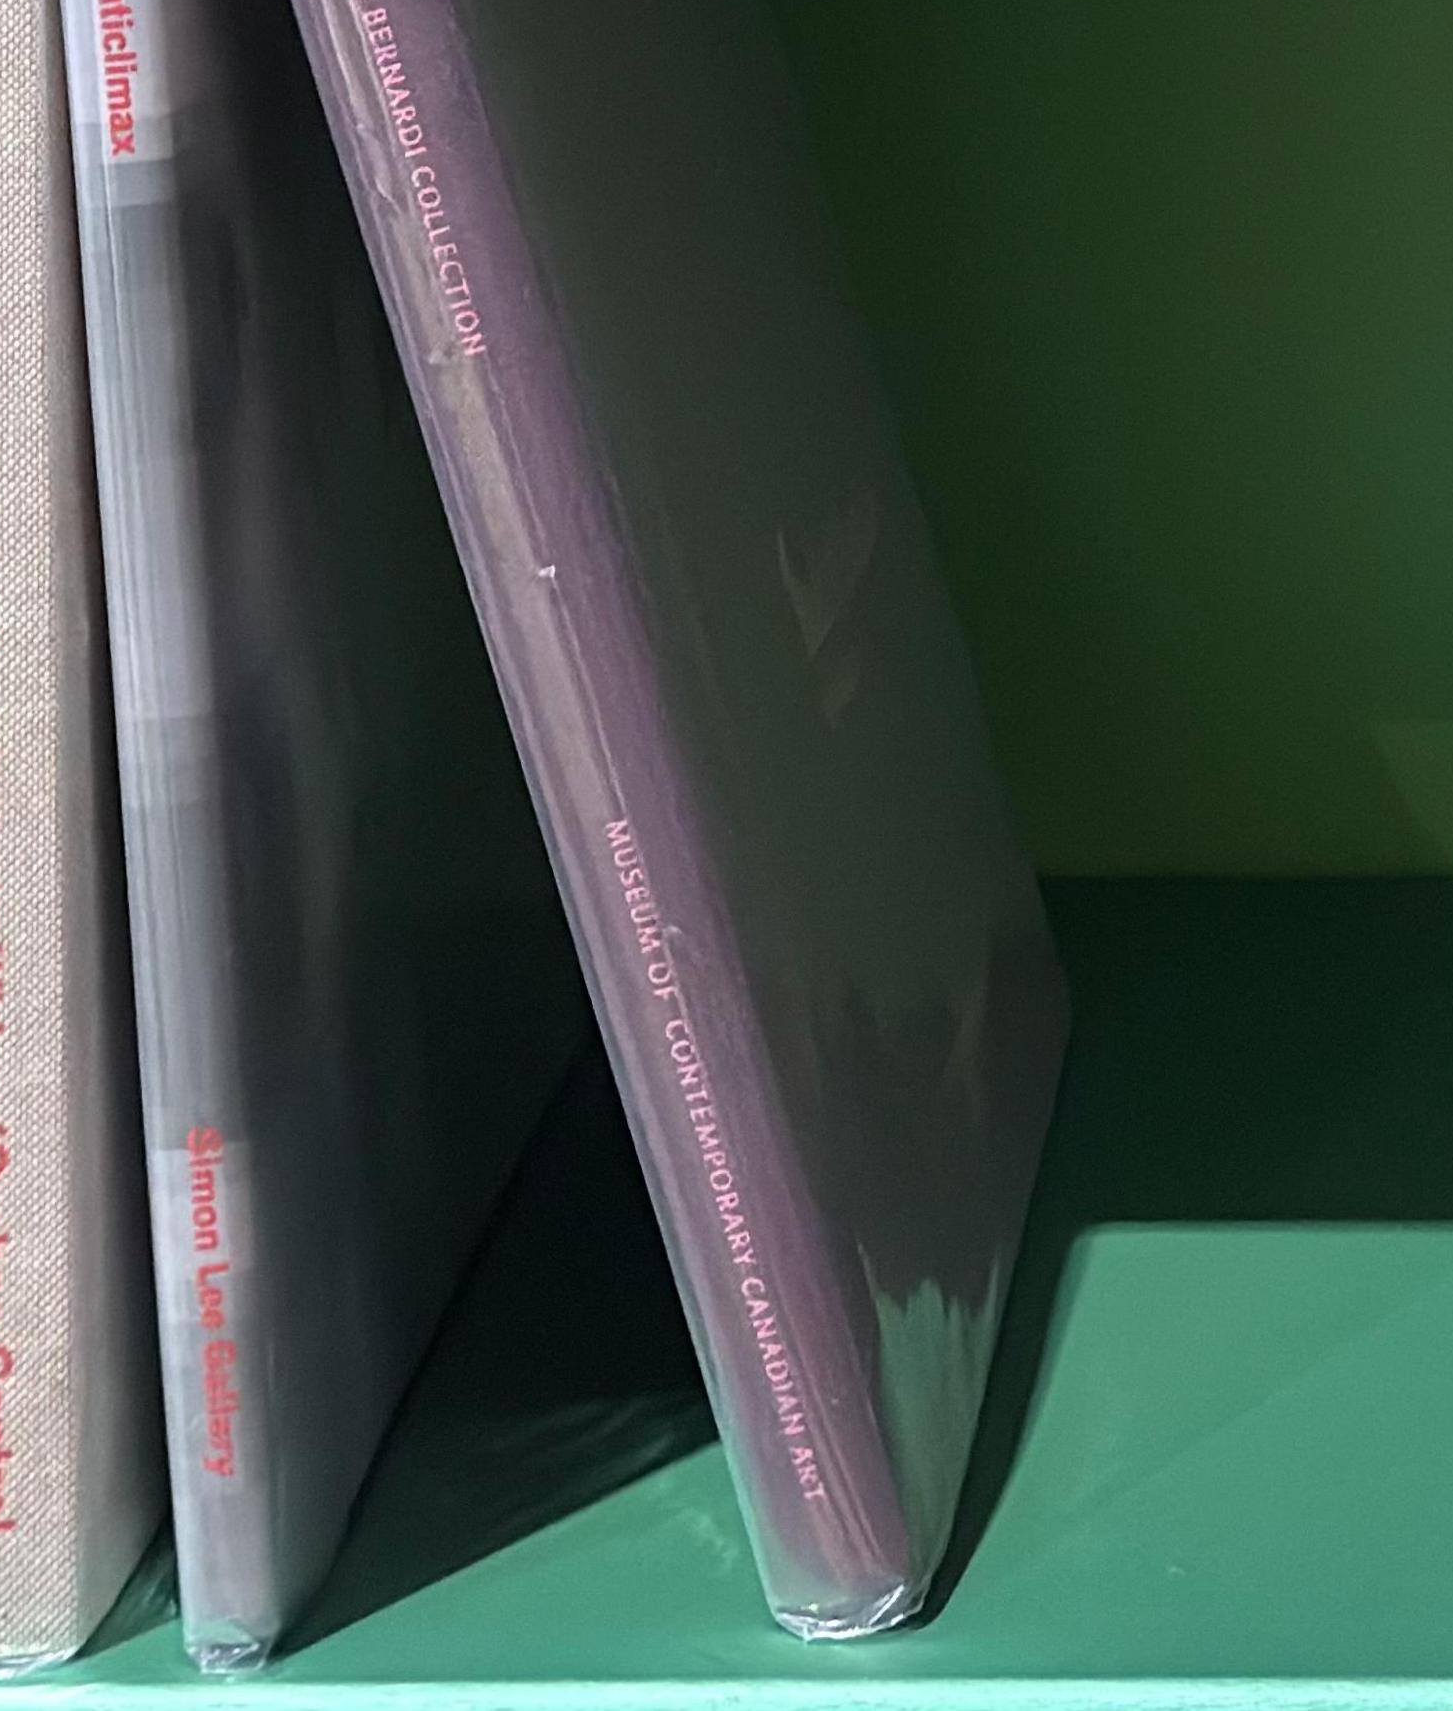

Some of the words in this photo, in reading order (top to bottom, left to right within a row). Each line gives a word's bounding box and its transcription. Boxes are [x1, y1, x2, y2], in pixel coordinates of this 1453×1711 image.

[362, 7, 427, 157] BERNARDI
[412, 166, 487, 357] COLLECTION
[187, 1125, 225, 1252] Simon
[606, 820, 661, 954] MUSEUM
[649, 961, 679, 1001] OF
[666, 1019, 756, 1265] CONTEMPORARY
[741, 1276, 806, 1437] CANADIAN
[789, 1444, 826, 1501] ART
[195, 1262, 230, 1331] Lee
[202, 1339, 240, 1477] Gallery
